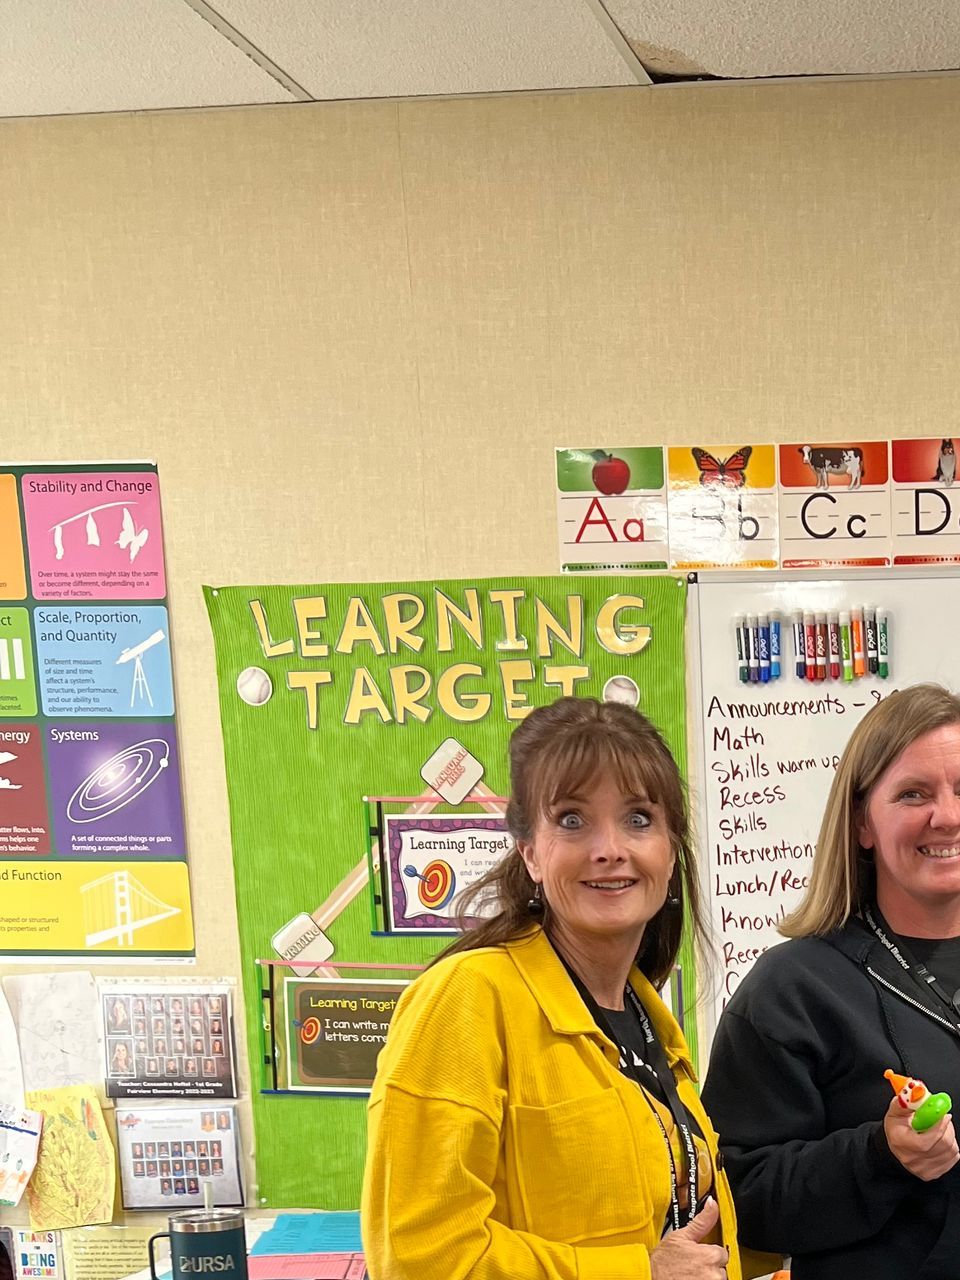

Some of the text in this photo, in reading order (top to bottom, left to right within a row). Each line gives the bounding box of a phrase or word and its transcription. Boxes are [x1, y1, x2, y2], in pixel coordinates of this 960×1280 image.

[29, 480, 152, 495] Stability and Change
[575, 497, 645, 544] Aa
[800, 492, 868, 540] Cc
[76, 572, 97, 580] system
[98, 571, 116, 579] might
[118, 571, 130, 579] stay
[38, 611, 142, 626] Scale, Proportion,
[249, 587, 652, 659] LEARNING
[40, 630, 117, 644] and Quantity
[287, 658, 590, 730] TARGET
[707, 693, 846, 719] Announcements
[0, 730, 31, 743] nergy
[51, 729, 99, 743] Systems
[713, 726, 765, 752] Math
[712, 752, 841, 784] Skills warm up
[720, 784, 786, 810] Recess
[718, 812, 768, 840] Skills
[128, 835, 148, 843] things
[410, 836, 509, 853] Learning Target
[72, 844, 97, 852] forming
[102, 844, 128, 852] complex
[716, 839, 816, 866] Intervention
[12, 869, 62, 881] Function
[715, 868, 809, 897] Lunch/Rec
[310, 997, 397, 1011] Learning Target
[325, 1018, 378, 1030] I can write
[325, 1031, 388, 1042] letters corre
[19, 1232, 53, 1243] THANKS
[21, 1252, 55, 1267] BEING
